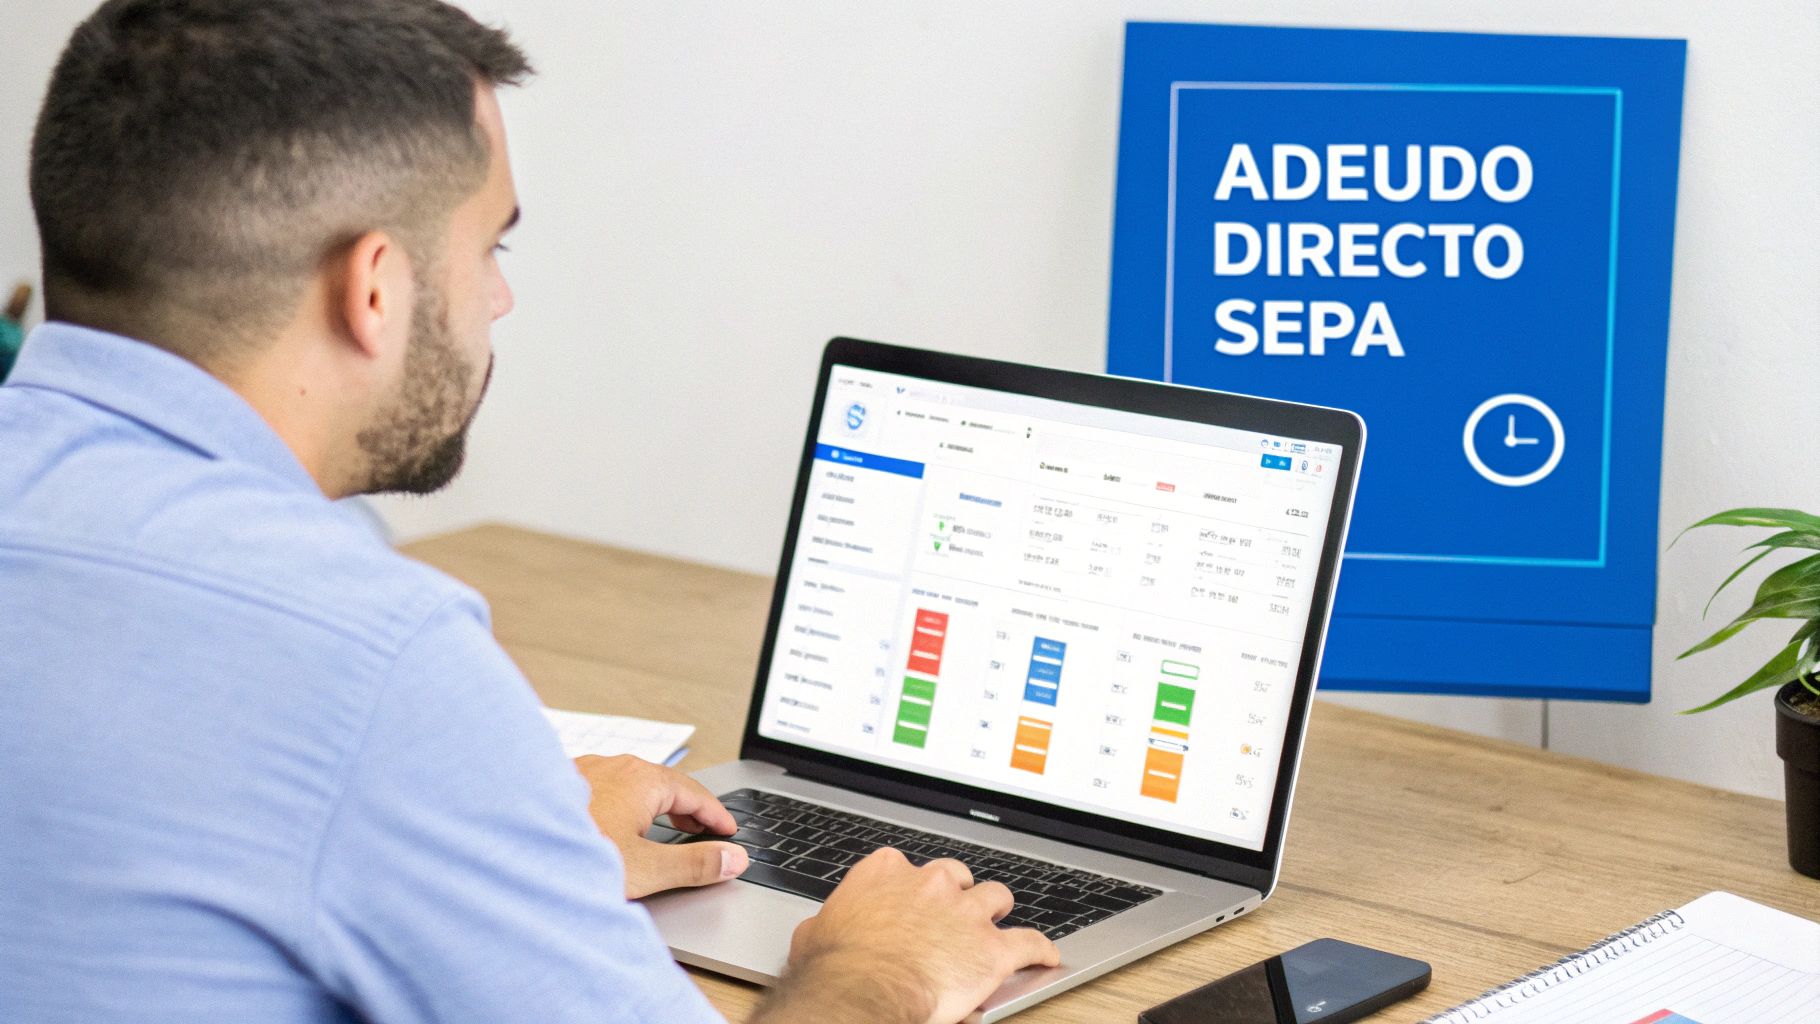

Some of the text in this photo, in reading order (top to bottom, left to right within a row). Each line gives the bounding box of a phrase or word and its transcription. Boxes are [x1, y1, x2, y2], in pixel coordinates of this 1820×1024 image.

[1214, 143, 1533, 203] ADEUDO
[1214, 222, 1524, 279] DIRECTO
[1214, 299, 1405, 357] SEPA
